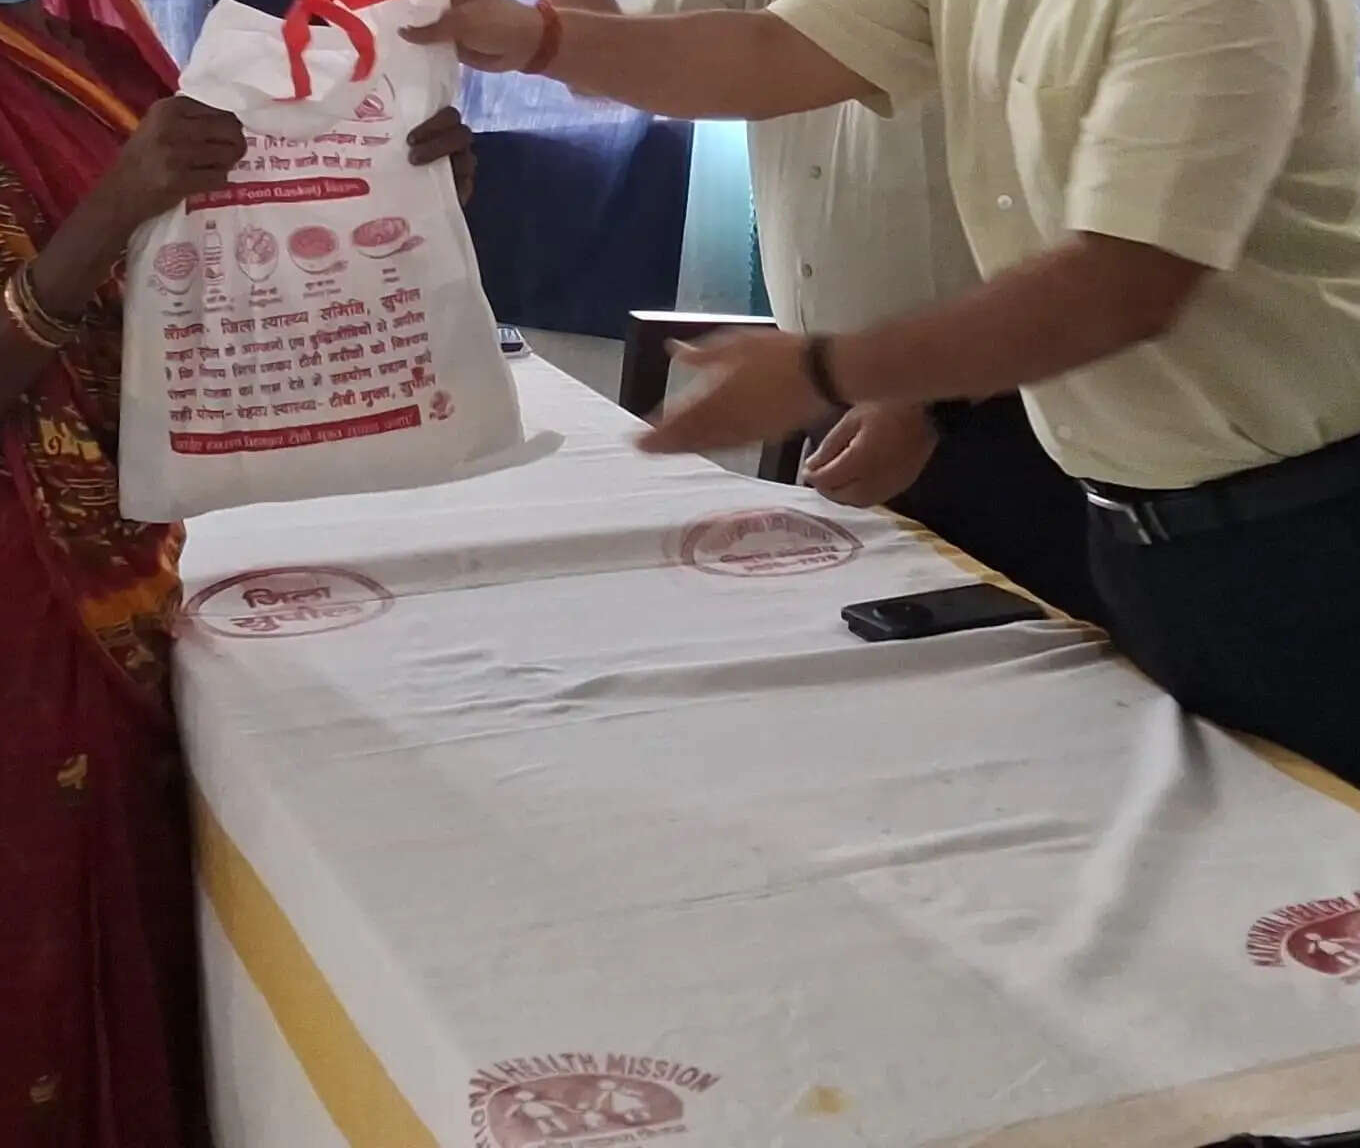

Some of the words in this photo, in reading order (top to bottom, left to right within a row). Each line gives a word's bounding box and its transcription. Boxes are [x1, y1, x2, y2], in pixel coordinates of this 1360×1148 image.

[221, 317, 256, 334] जिला
[242, 586, 332, 609] जिला
[604, 1052, 723, 1094] MISSION
